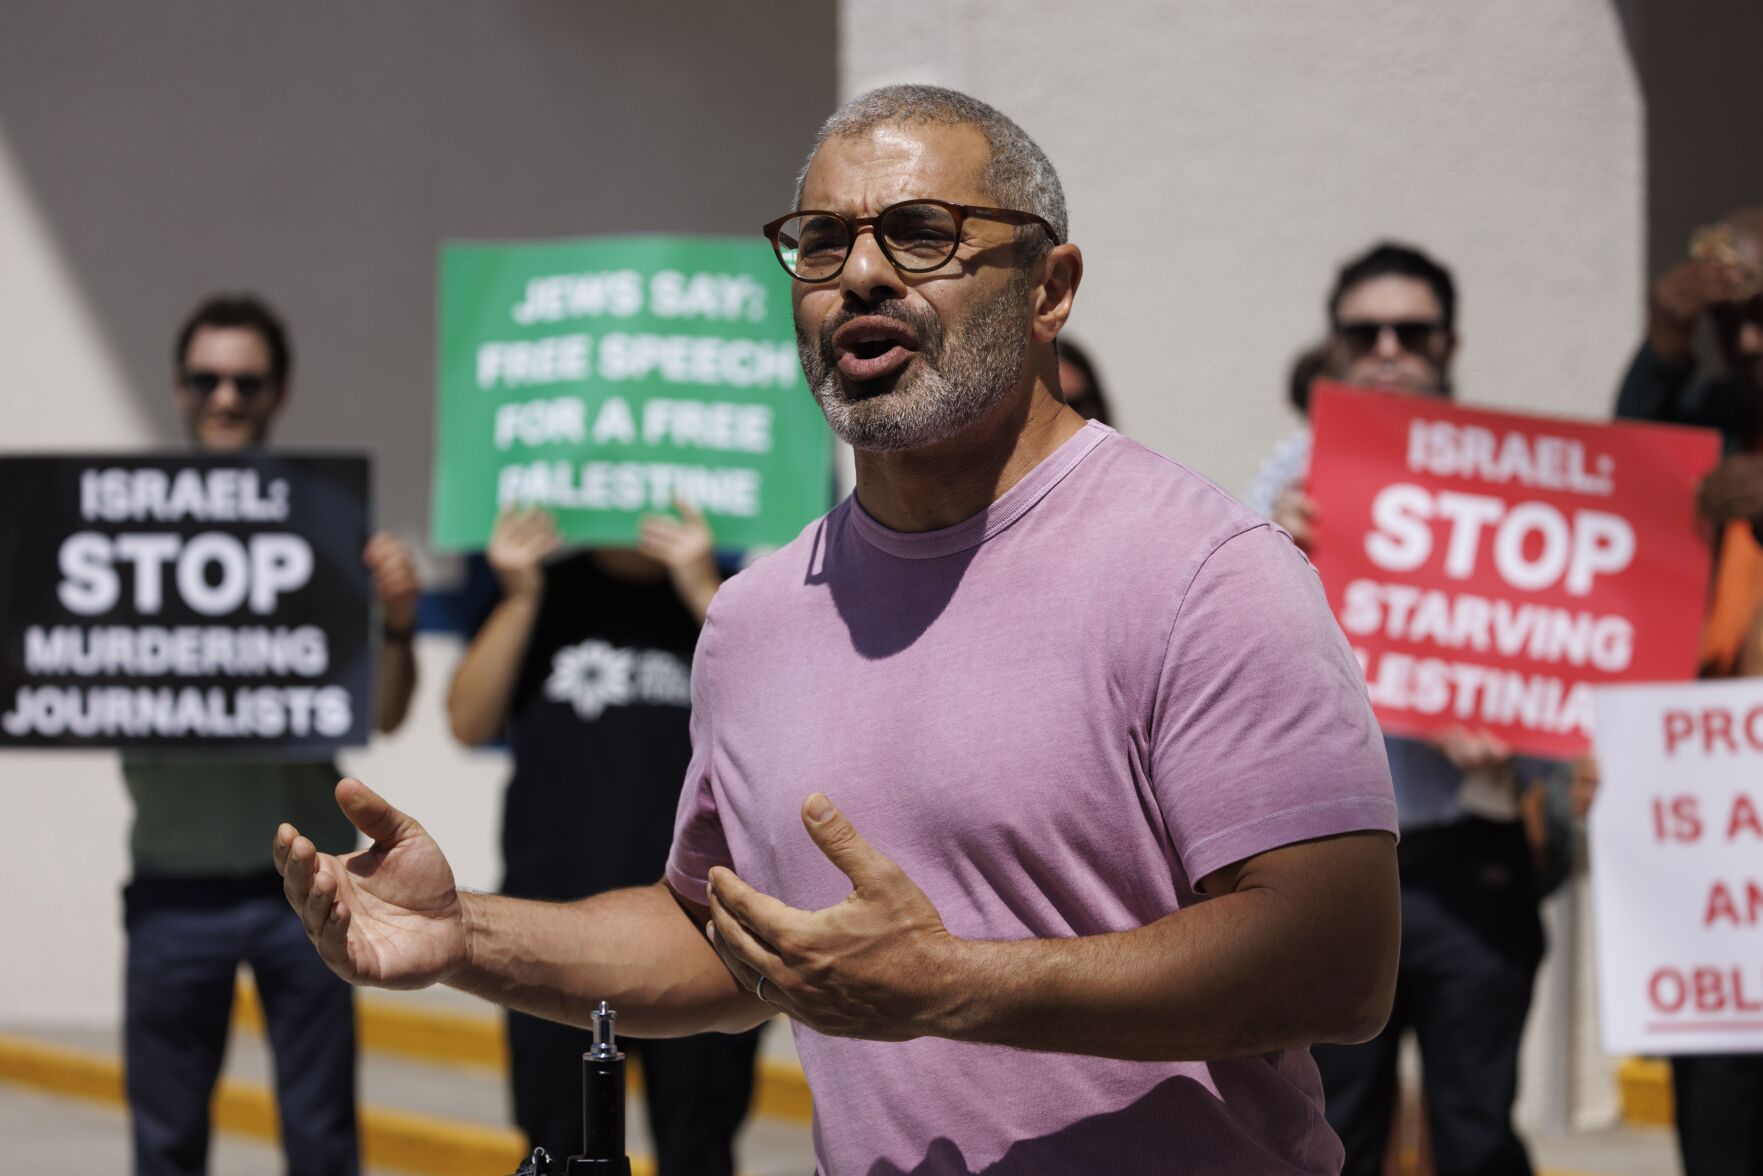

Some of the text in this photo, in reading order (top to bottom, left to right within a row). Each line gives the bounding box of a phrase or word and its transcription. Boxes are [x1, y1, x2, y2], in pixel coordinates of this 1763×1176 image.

[512, 270, 767, 325] JEWS SAY:
[476, 333, 797, 390] FREE SPEECH
[494, 397, 775, 453] FOR A FREE
[1407, 418, 1615, 496] ISRAEL:
[81, 468, 290, 521] ISRAEL:
[497, 461, 762, 516] PALESTINE
[1364, 483, 1636, 597] STOP
[57, 531, 314, 616] STOP
[25, 625, 328, 677] MURDERING
[1341, 579, 1634, 672] STARVING
[3, 685, 352, 737] JOURNALISTS
[1651, 794, 1703, 845] IS
